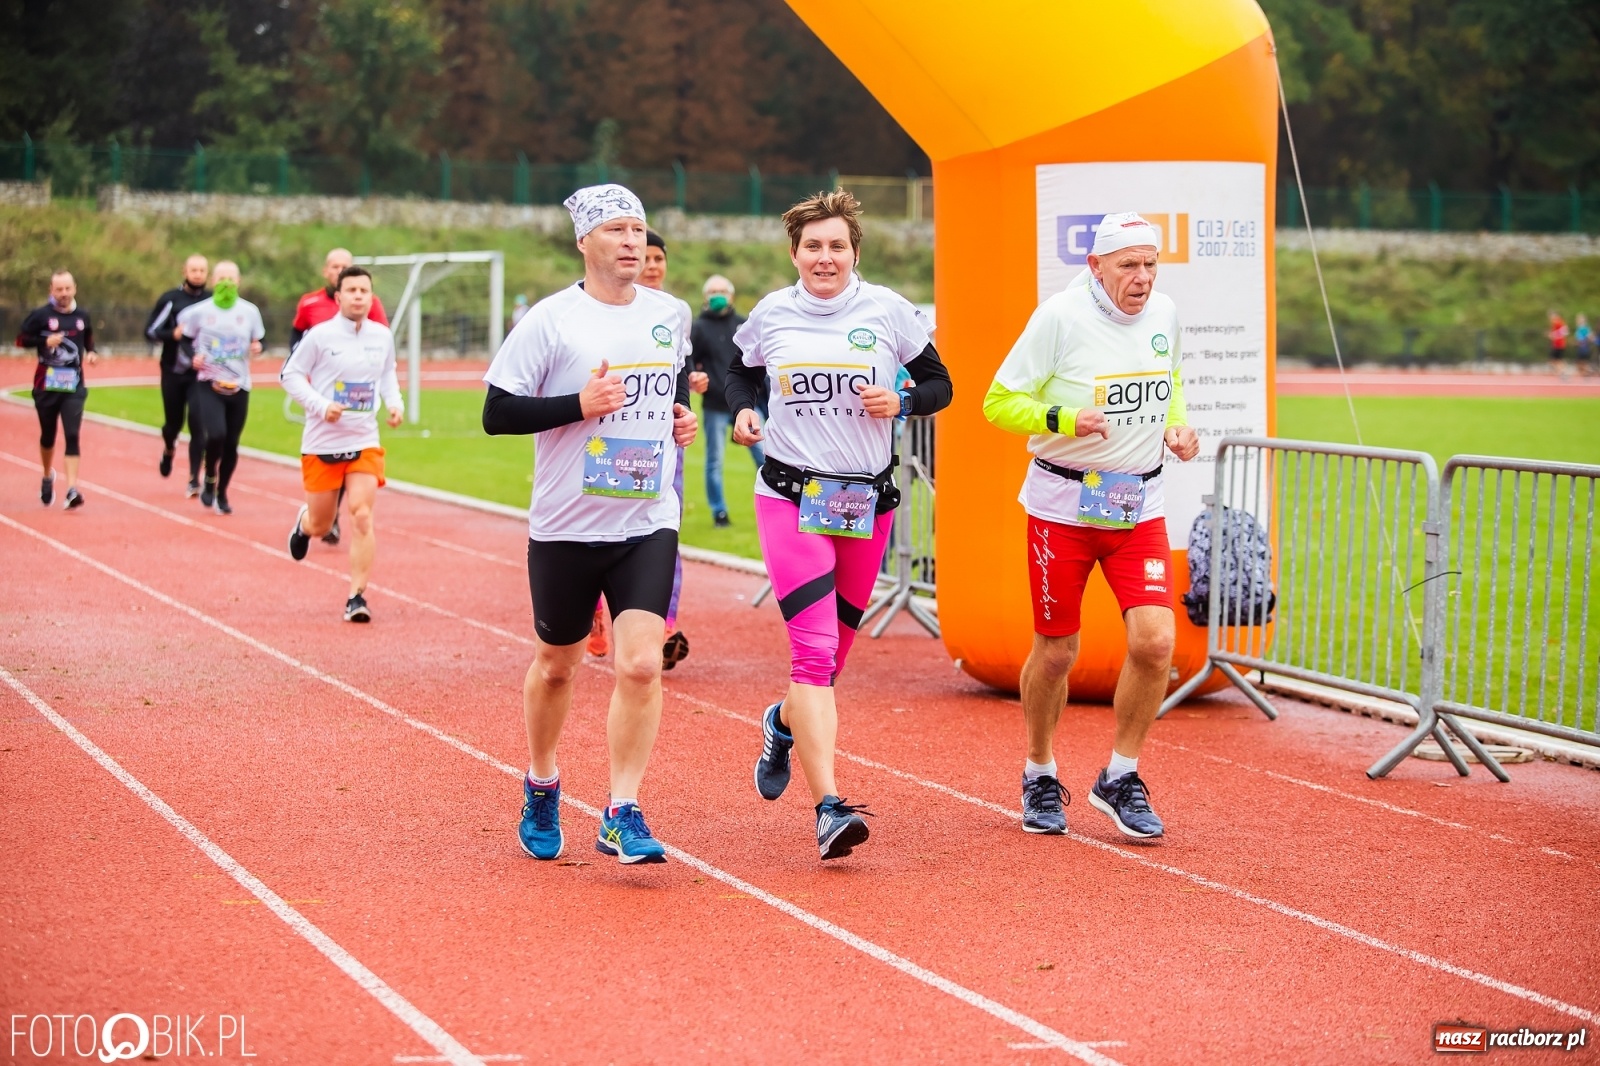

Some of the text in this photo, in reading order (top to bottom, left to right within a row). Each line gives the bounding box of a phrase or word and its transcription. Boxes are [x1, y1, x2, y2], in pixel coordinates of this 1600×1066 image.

[622, 364, 675, 408] grol
[796, 407, 866, 418] KIETRZ
[1185, 403, 1213, 412] duszu
[1107, 413, 1165, 427] IETRZ
[596, 458, 612, 466] BIEG
[615, 459, 629, 467] DLA
[632, 479, 655, 490] 233
[1119, 511, 1138, 521] 255
[840, 518, 866, 530] 256
